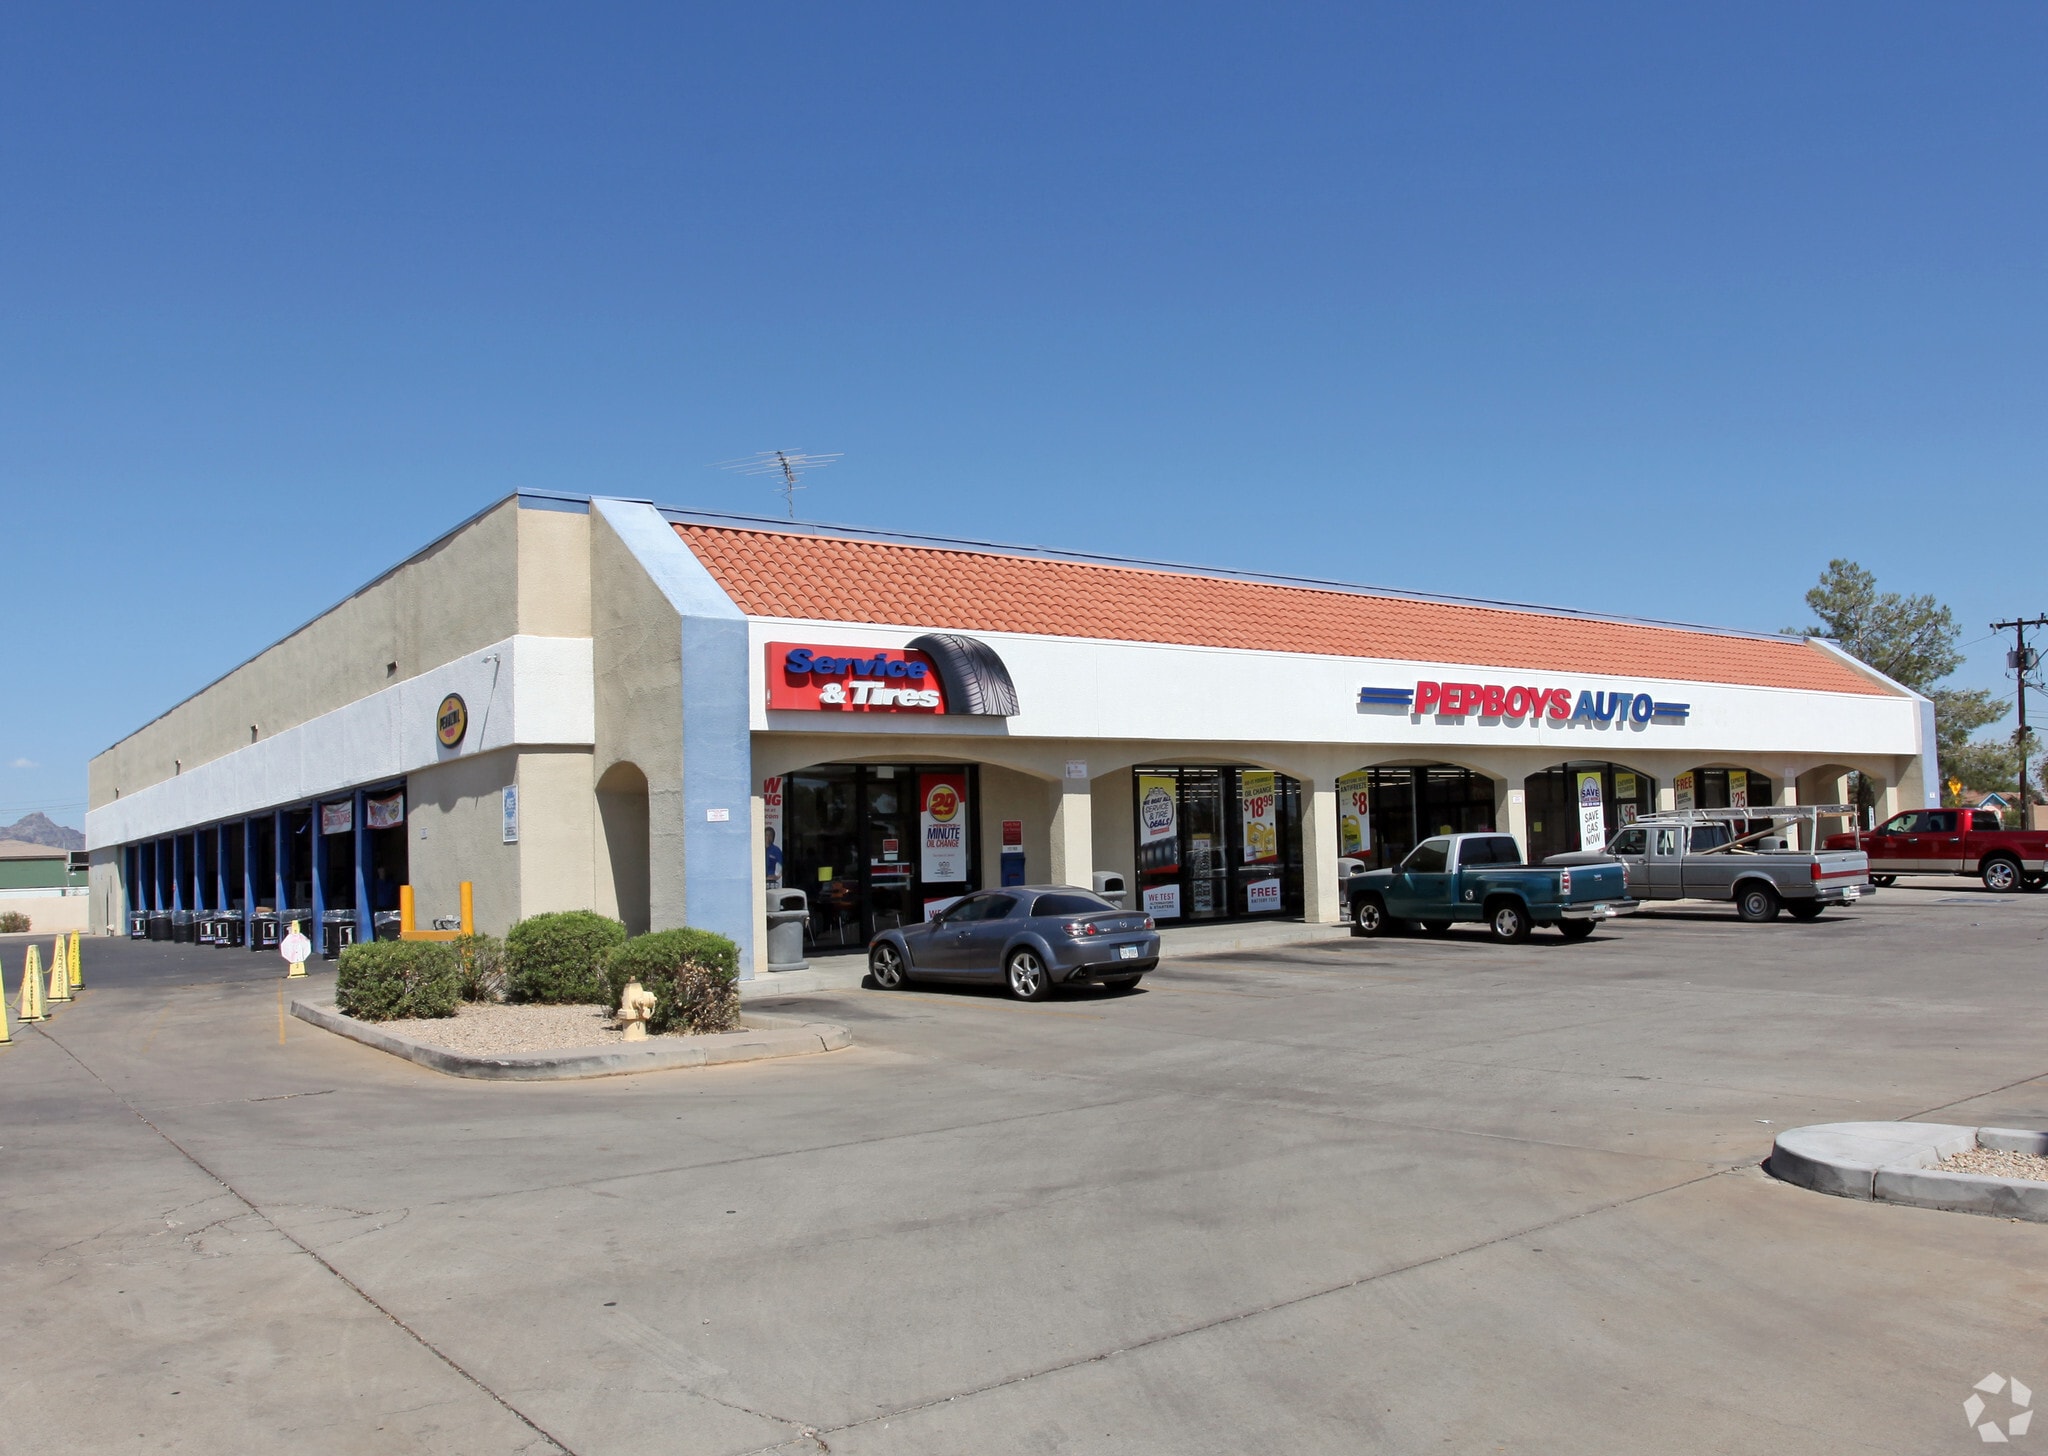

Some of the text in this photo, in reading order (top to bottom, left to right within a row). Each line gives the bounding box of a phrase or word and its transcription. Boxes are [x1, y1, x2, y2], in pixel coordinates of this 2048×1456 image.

[786, 648, 929, 679] Service
[819, 680, 940, 708] & Tires
[1676, 776, 1693, 791] FREE
[1244, 786, 1272, 797] OIL CHANGE
[1581, 789, 1600, 798] SAVE
[930, 792, 958, 815] 29
[1352, 791, 1368, 816] $8
[1731, 791, 1746, 808] $25
[1145, 802, 1169, 813] SERVICE
[1149, 810, 1168, 820] & TIRE
[1584, 810, 1599, 823] SAVE
[1150, 817, 1170, 829] DEALS
[1586, 822, 1599, 834] GAS
[927, 827, 960, 840] MINUTE
[1585, 832, 1600, 846] NOW
[926, 840, 960, 848] OIL CHANGE
[1148, 892, 1175, 901] WE TEST
[1250, 886, 1278, 898] FREE
